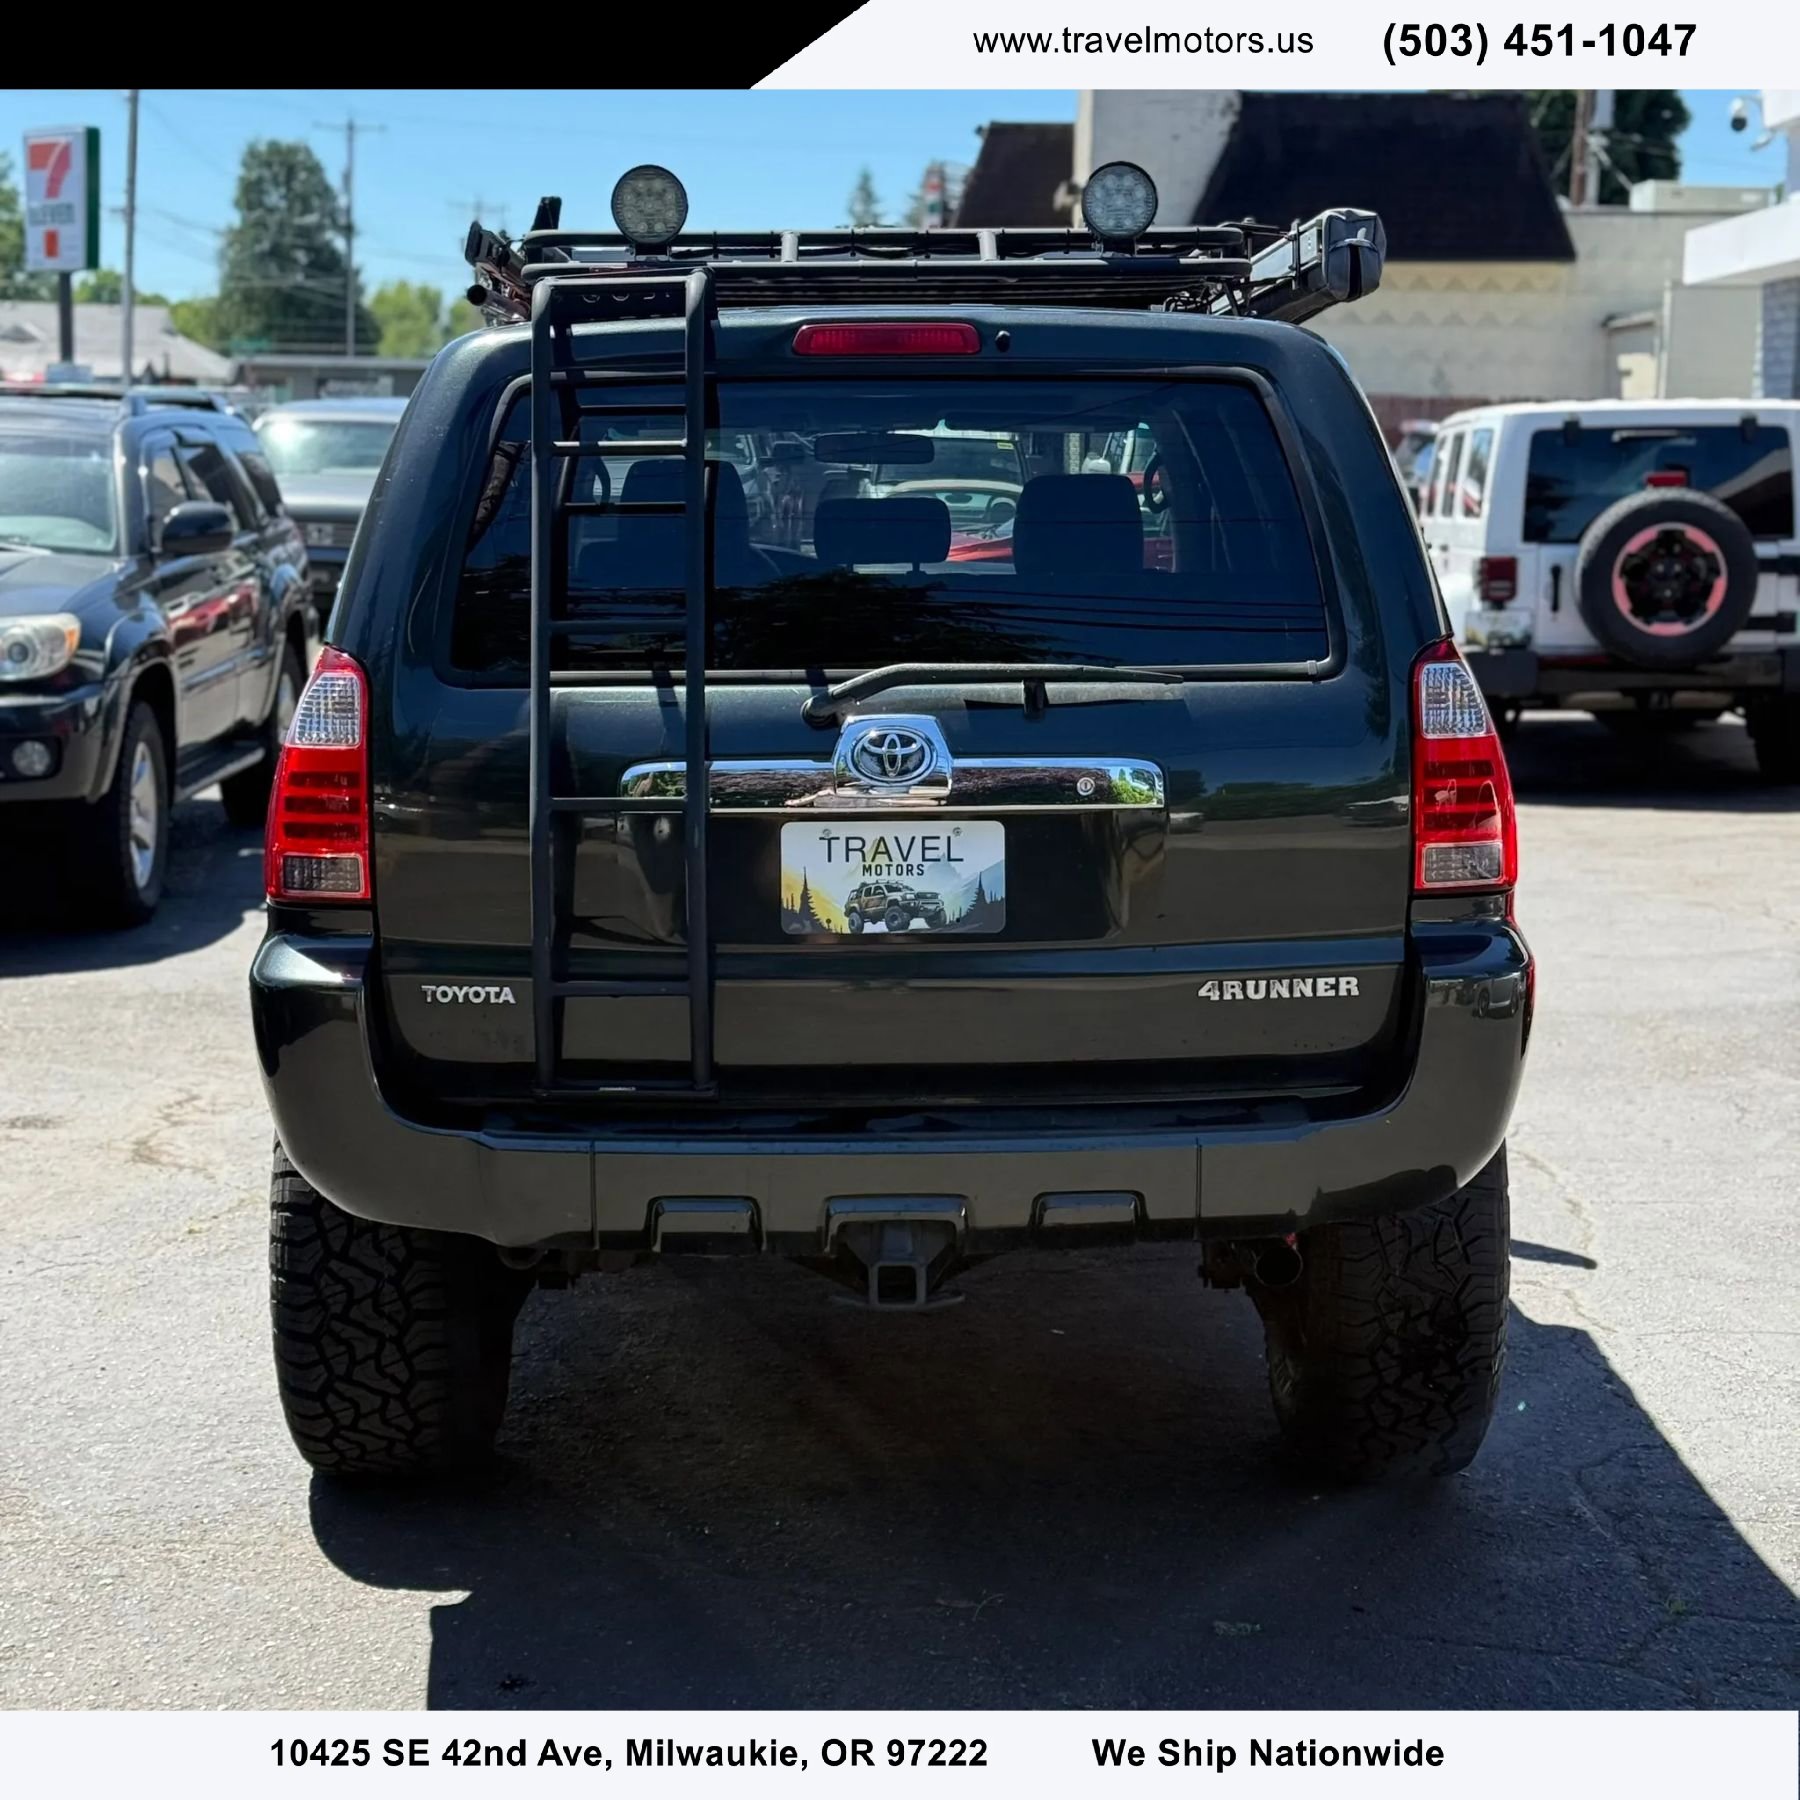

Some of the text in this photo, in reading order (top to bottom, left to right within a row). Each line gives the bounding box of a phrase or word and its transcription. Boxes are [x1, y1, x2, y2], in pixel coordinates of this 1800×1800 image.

[819, 835, 964, 863] TRAVEL
[862, 863, 925, 877] MOTORS
[421, 985, 516, 1004] TOYOTA
[1198, 976, 1360, 1001] 4RUNNER
